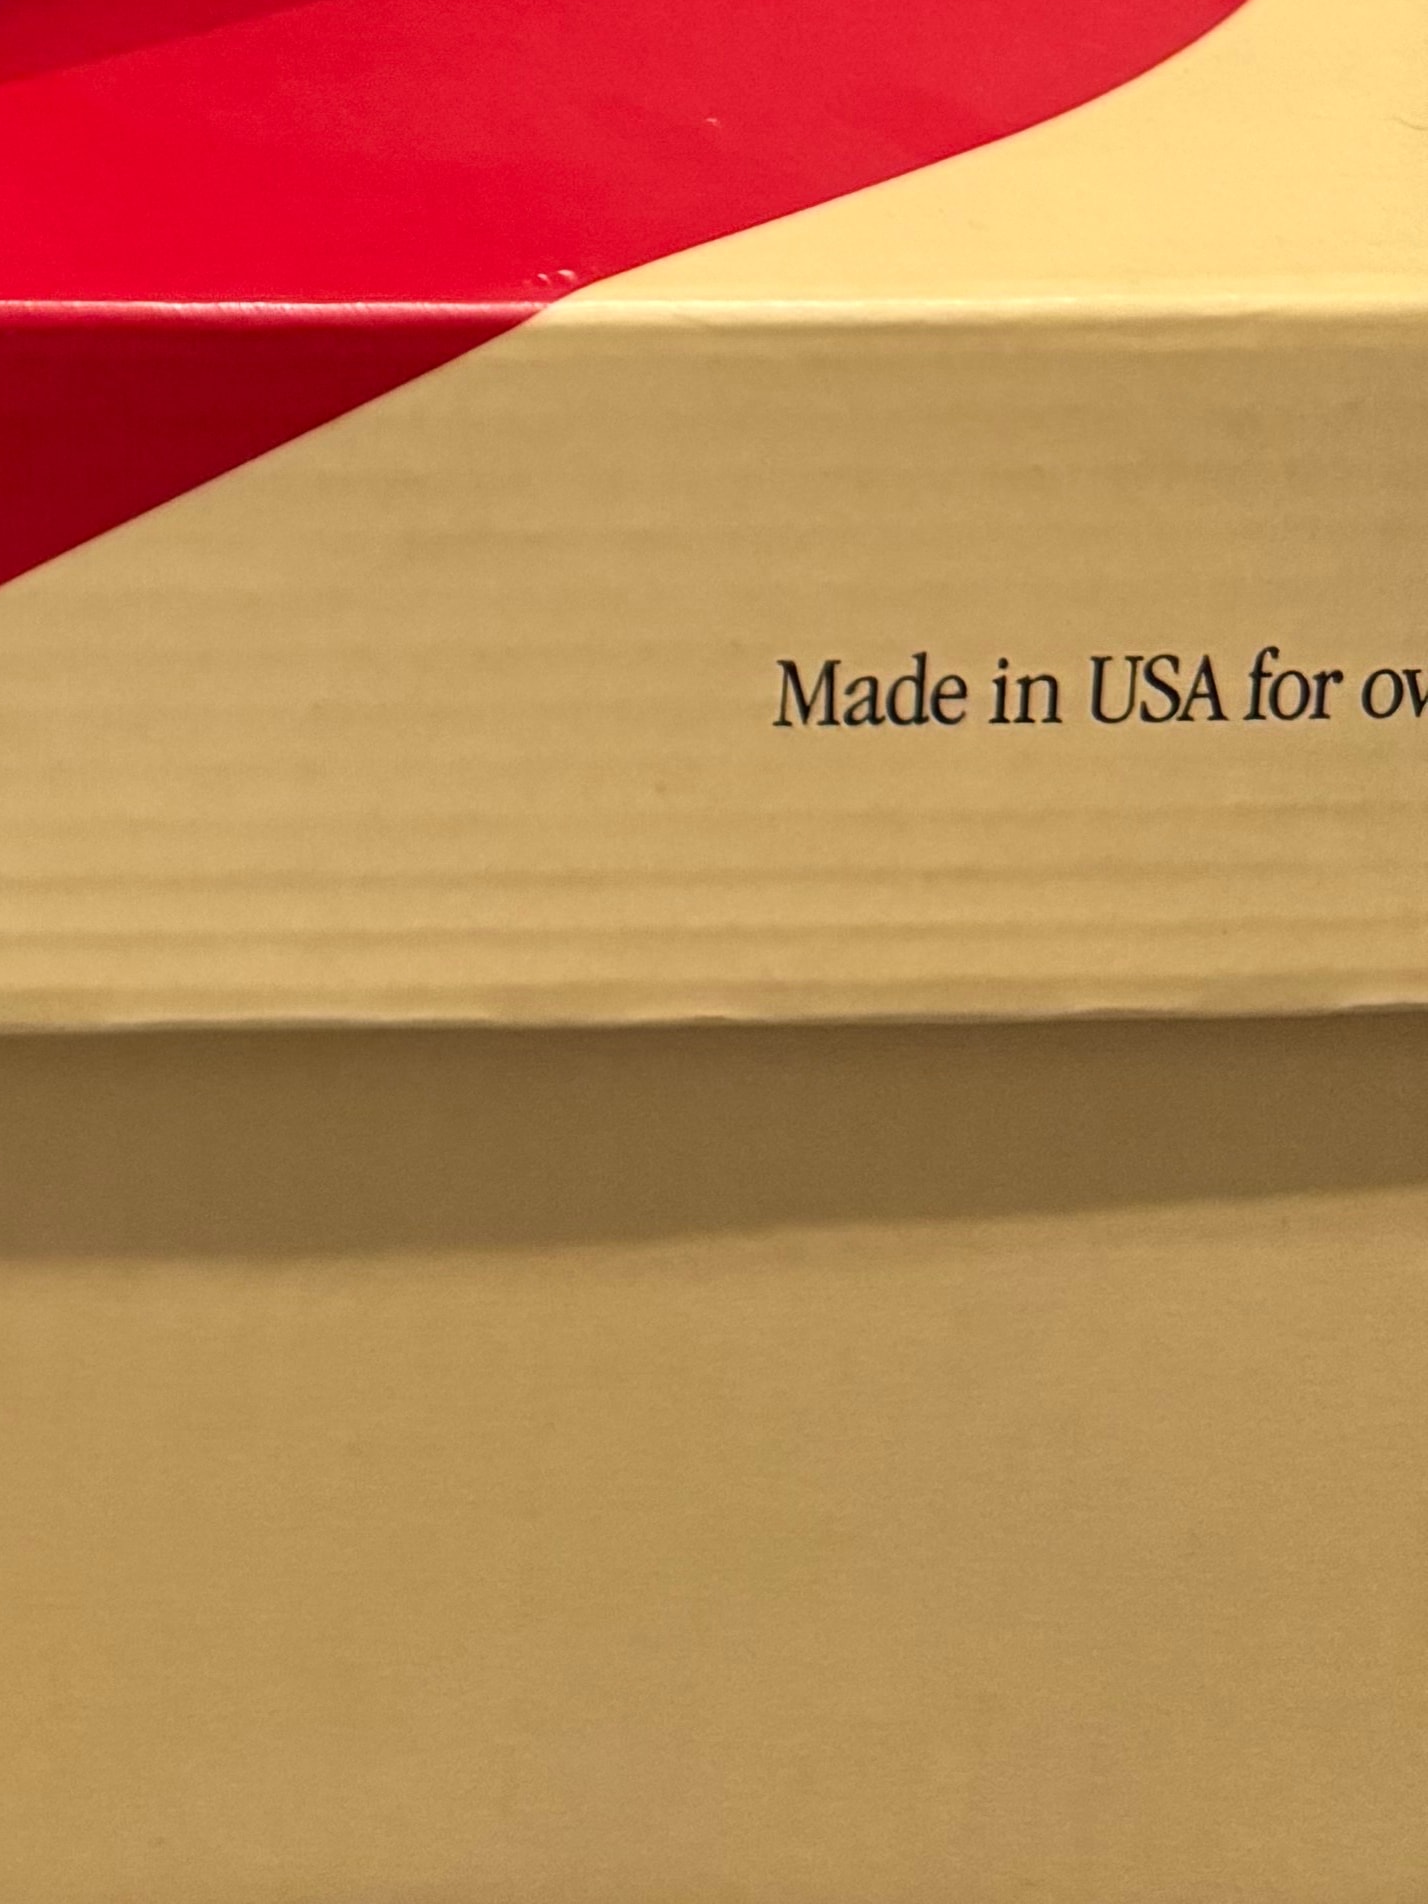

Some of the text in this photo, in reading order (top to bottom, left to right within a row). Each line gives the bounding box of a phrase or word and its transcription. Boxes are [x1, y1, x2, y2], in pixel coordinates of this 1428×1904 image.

[772, 651, 968, 728] Made
[988, 657, 1063, 725] in
[1090, 653, 1230, 725] USA
[1242, 645, 1345, 721] for
